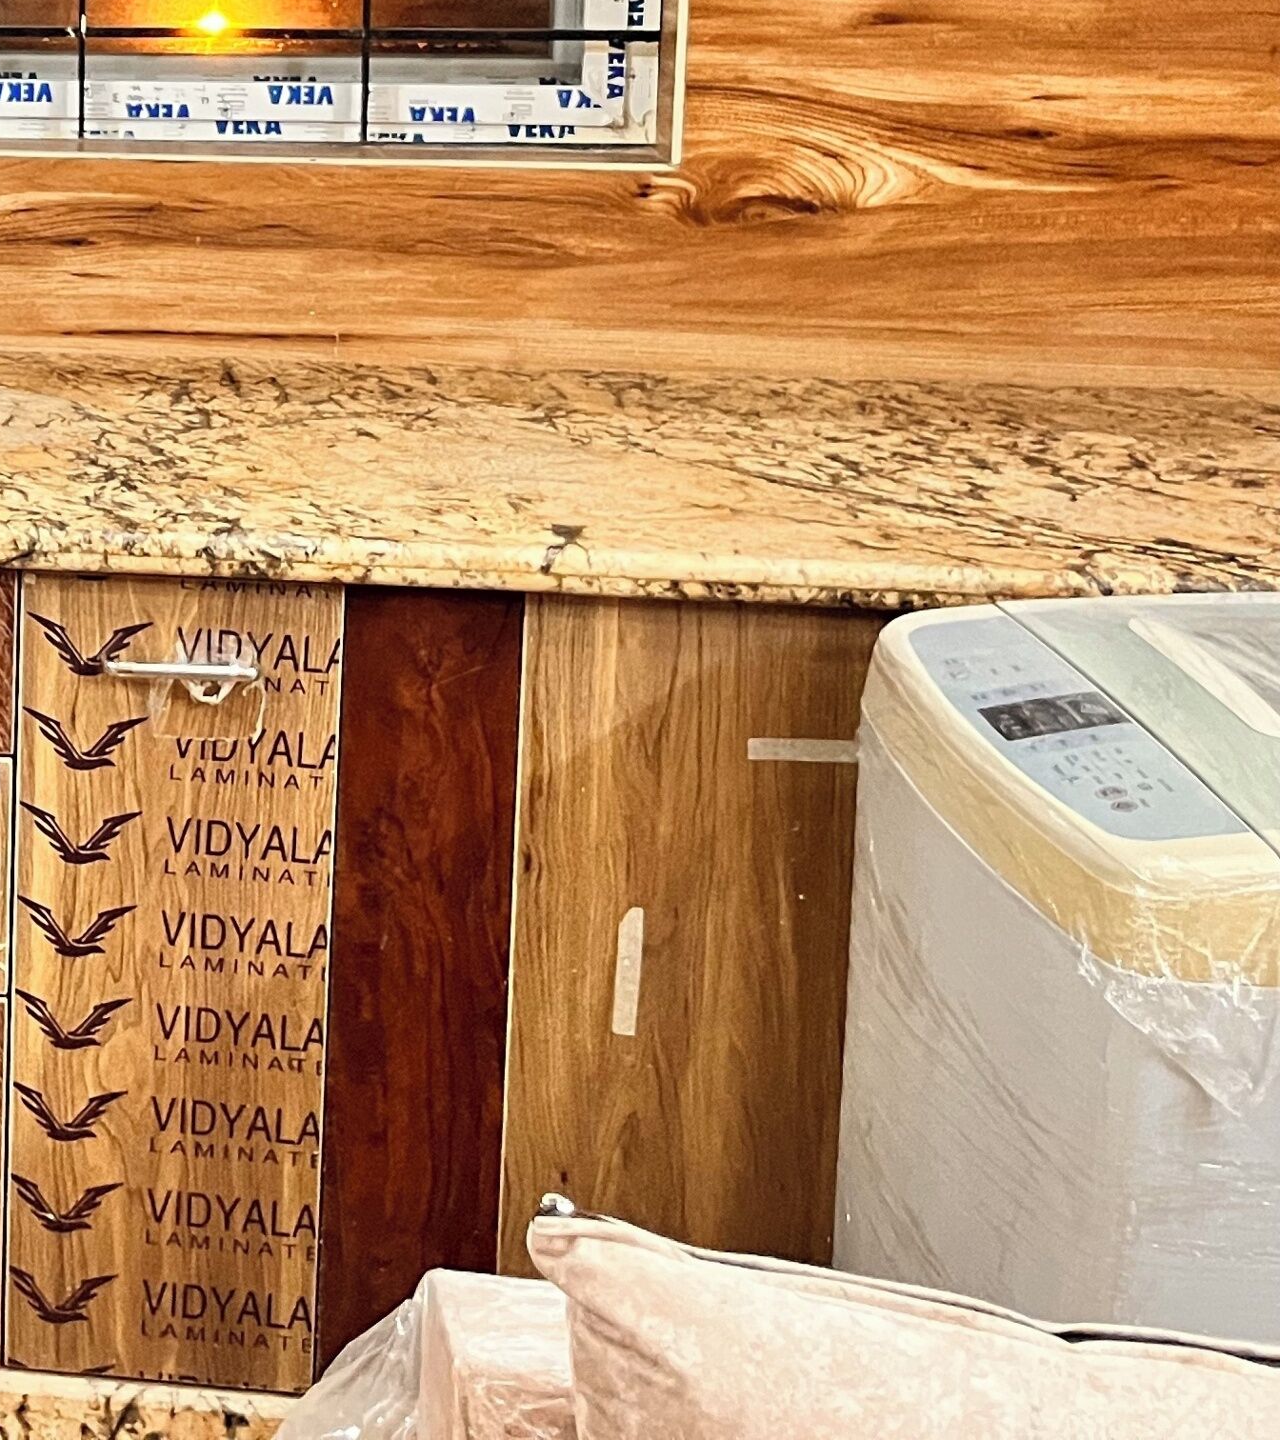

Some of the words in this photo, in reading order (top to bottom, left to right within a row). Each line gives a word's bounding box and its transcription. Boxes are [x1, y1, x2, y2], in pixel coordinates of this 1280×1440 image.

[267, 85, 334, 105] VEKA
[409, 106, 475, 123] VEKA
[164, 859, 329, 887] LAMINAT
[156, 1003, 324, 1052] VIDYALA
[151, 1095, 320, 1146] VIDYALA
[147, 1188, 317, 1239] VIDYALA
[142, 1279, 313, 1333] VIDYALA
